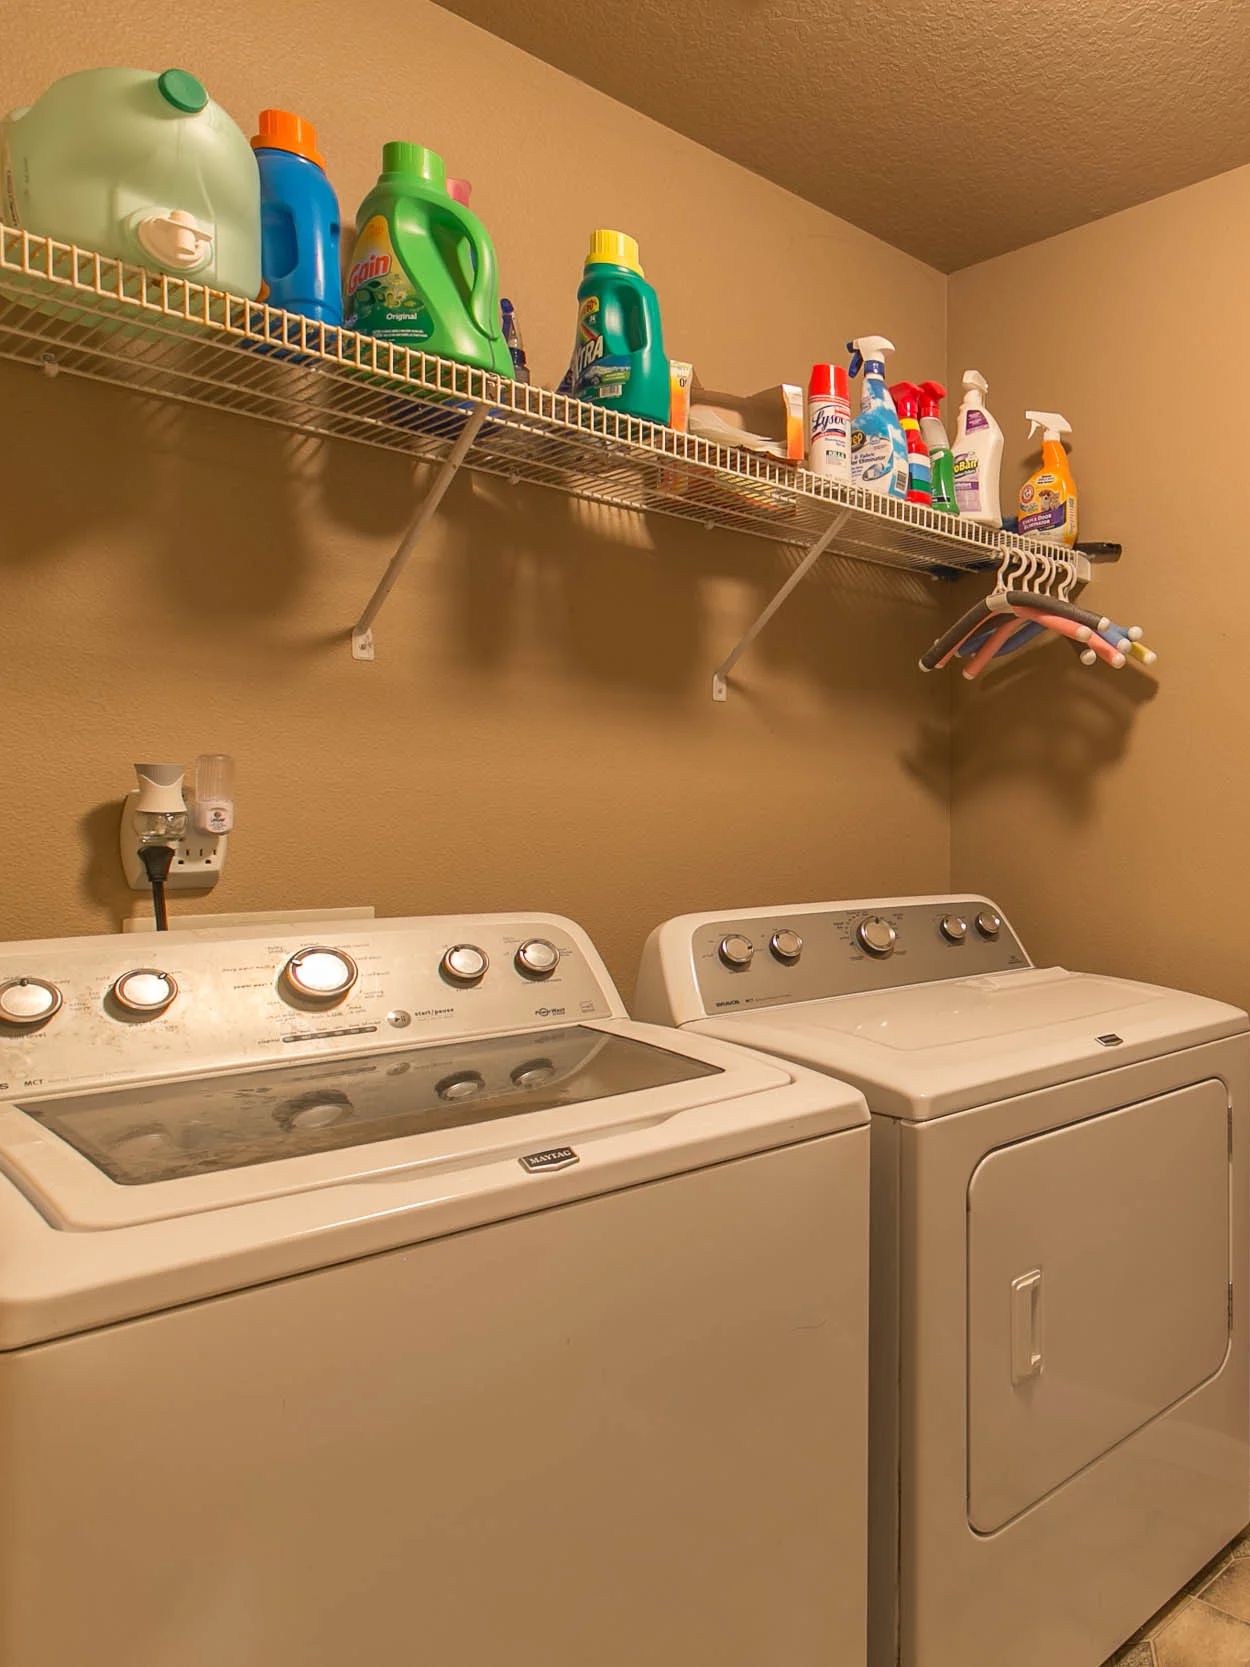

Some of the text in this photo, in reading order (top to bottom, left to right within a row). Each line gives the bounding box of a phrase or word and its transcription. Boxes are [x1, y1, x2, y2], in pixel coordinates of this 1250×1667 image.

[347, 252, 391, 296] Gain
[386, 312, 418, 321] Original
[24, 1079, 45, 1087] MCT
[529, 1149, 572, 1165] MAYTAG
